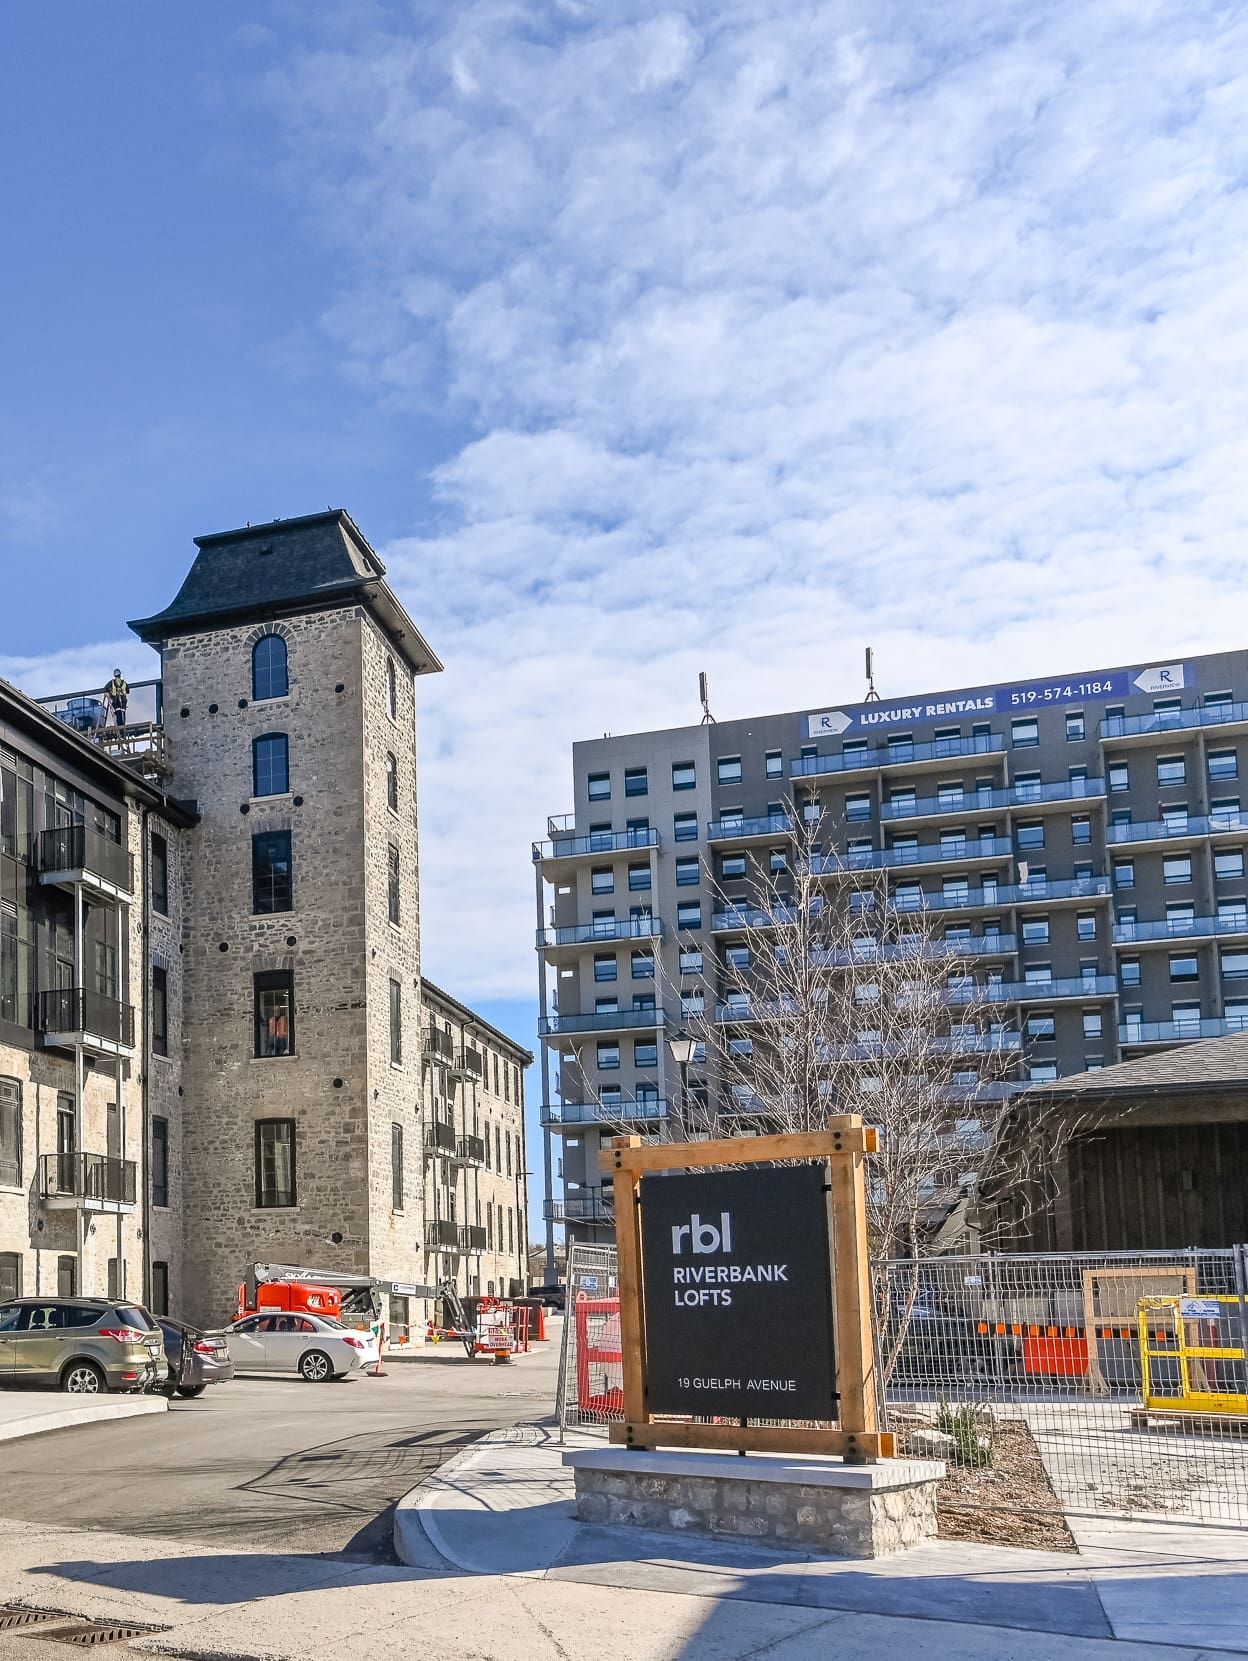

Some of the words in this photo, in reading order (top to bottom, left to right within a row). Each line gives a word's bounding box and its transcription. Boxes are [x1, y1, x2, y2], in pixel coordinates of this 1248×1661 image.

[860, 706, 923, 725] LUXURY
[926, 697, 994, 716] RENTALS
[1011, 680, 1113, 705] 519-574-1184
[671, 1212, 732, 1254] rbl
[673, 1264, 788, 1284] RIVERBANK
[674, 1289, 732, 1306] LOFTS
[677, 1377, 691, 1389] 19
[693, 1378, 741, 1390] GUELPH
[746, 1379, 796, 1391] AVENUE
